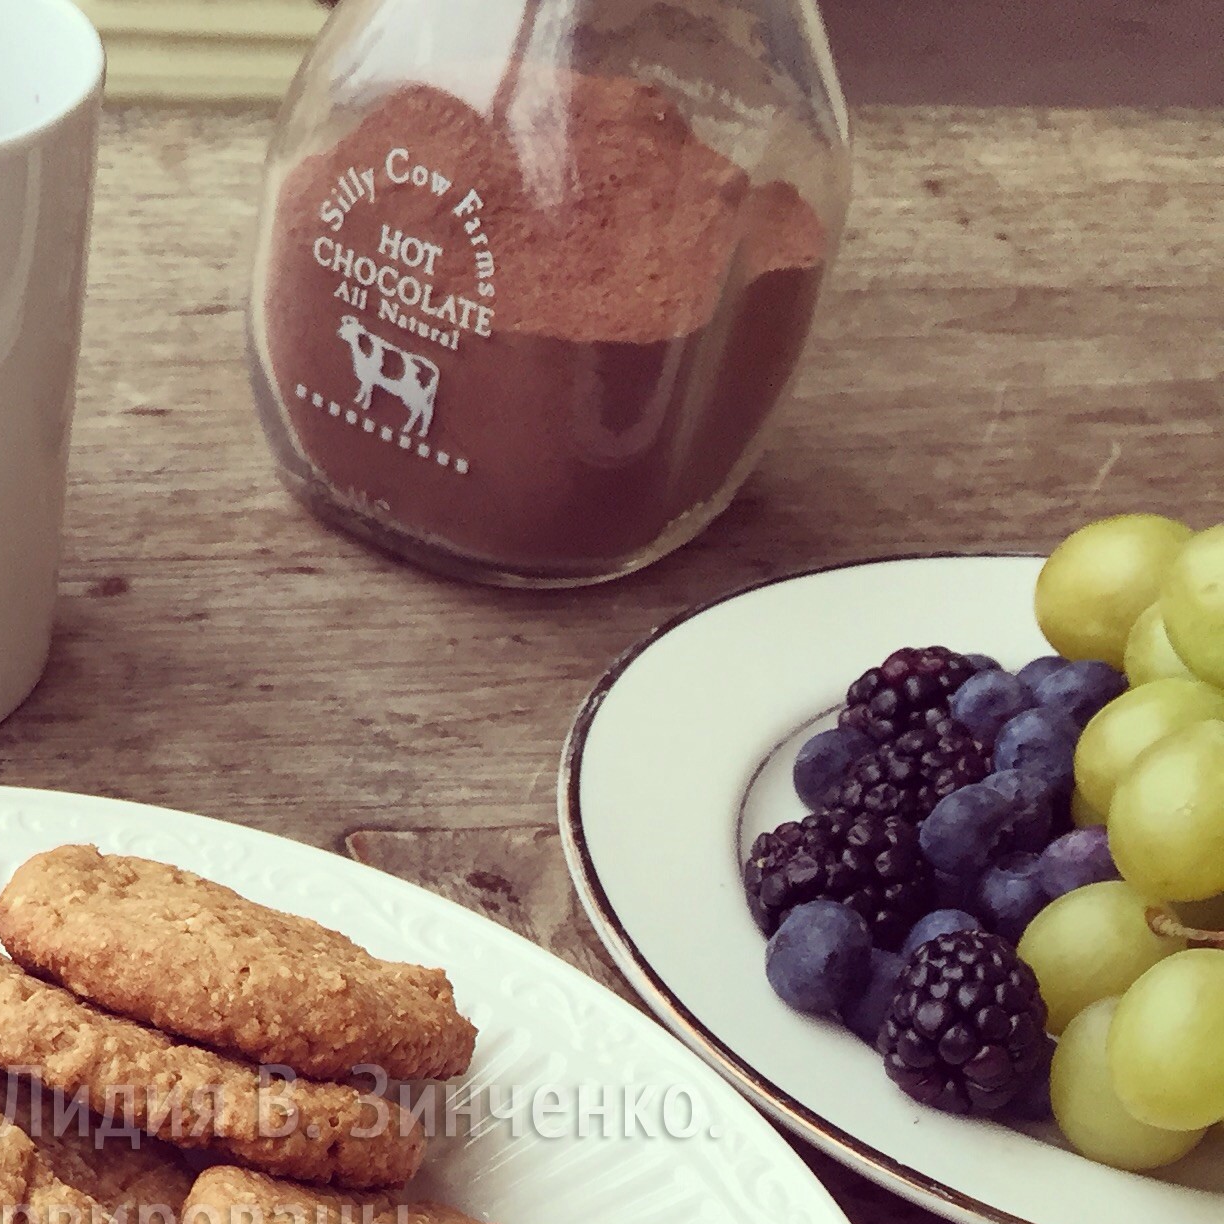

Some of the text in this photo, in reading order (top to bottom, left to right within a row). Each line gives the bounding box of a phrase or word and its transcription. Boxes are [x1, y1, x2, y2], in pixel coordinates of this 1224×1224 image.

[320, 147, 496, 298] Silly Cow Farms
[377, 223, 444, 276] HOT
[313, 236, 496, 338] CHOCOLATE
[333, 280, 461, 351] All Natural
